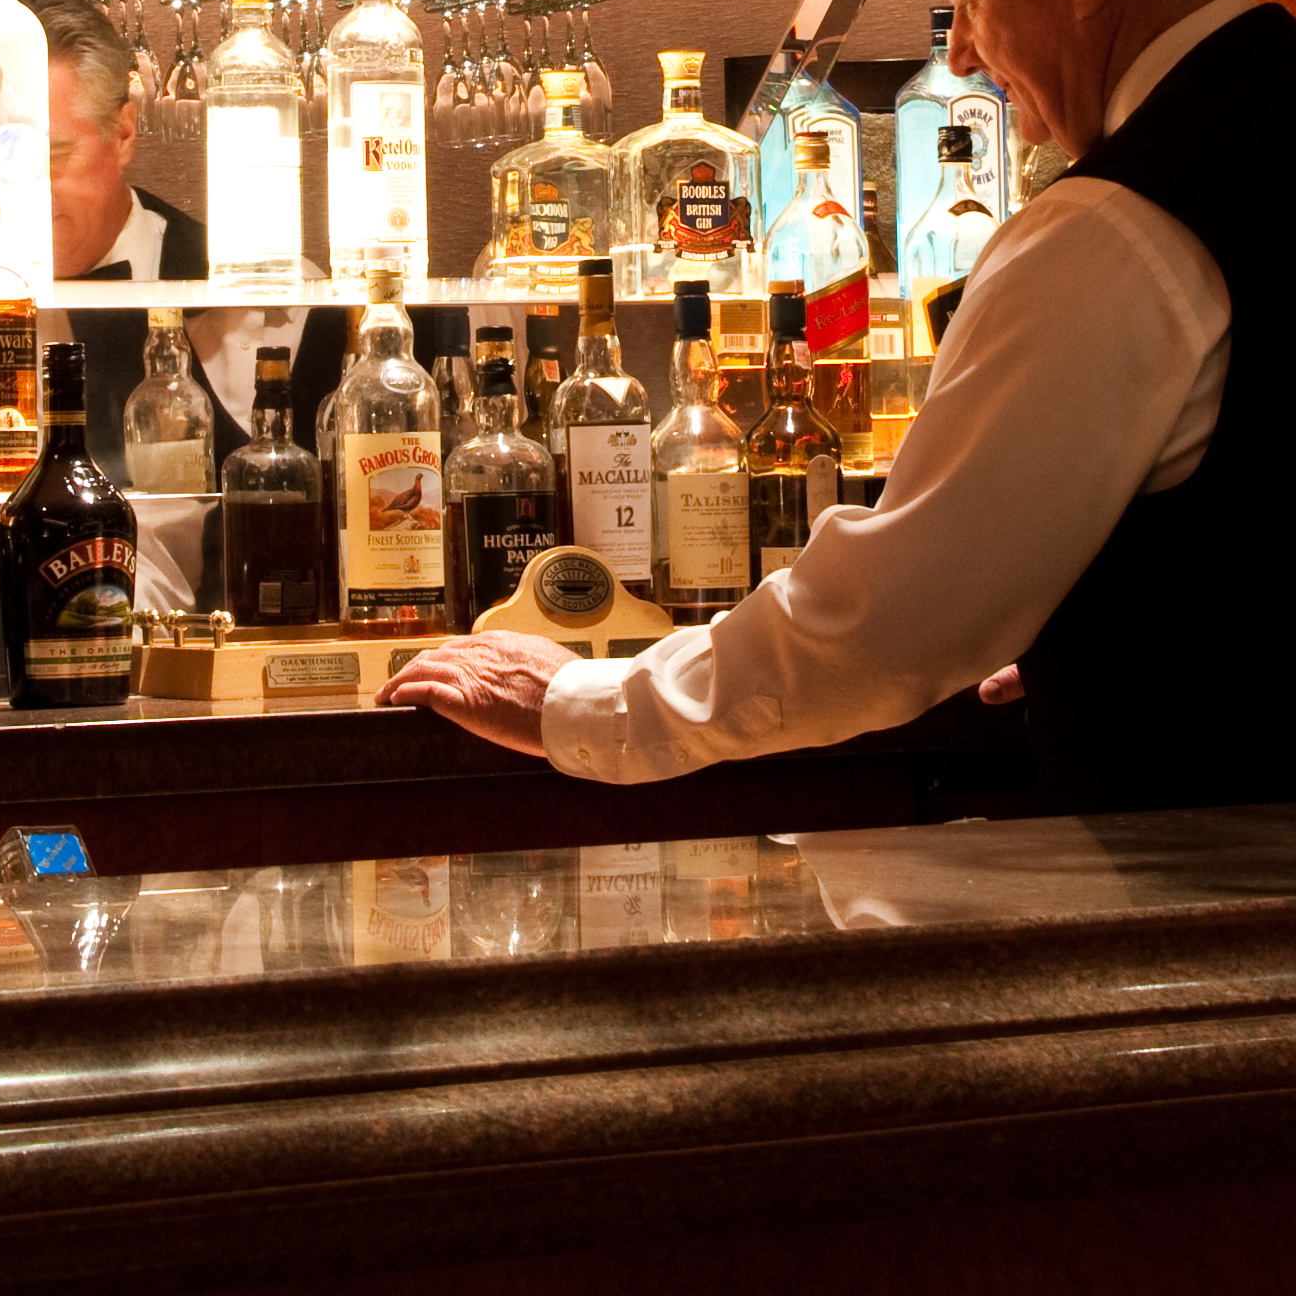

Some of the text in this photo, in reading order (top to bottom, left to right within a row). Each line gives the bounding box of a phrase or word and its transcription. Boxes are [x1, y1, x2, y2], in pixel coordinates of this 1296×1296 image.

[957, 108, 993, 127] BOMBAY
[364, 137, 403, 171] Ketel
[386, 161, 417, 171] VODKA
[682, 185, 725, 199] BOODLES
[686, 204, 722, 216] BRITISH
[695, 217, 712, 229] GIN
[1, 351, 15, 364] 12
[401, 438, 420, 446] THE
[358, 449, 410, 475] FAMOUS
[612, 454, 632, 468] The
[615, 505, 635, 527] 12
[368, 534, 393, 546] FINEST
[396, 534, 423, 545] SCOTCH
[484, 533, 555, 548] HIGHLAND
[48, 540, 136, 580] BAILEYS
[507, 549, 543, 563] PAR
[546, 560, 602, 579] CLASSIC MALTS
[720, 557, 733, 575] 10
[550, 593, 602, 608] OF SCOTLAND
[49, 648, 77, 656] THE
[281, 657, 344, 667] DALWHINNIE
